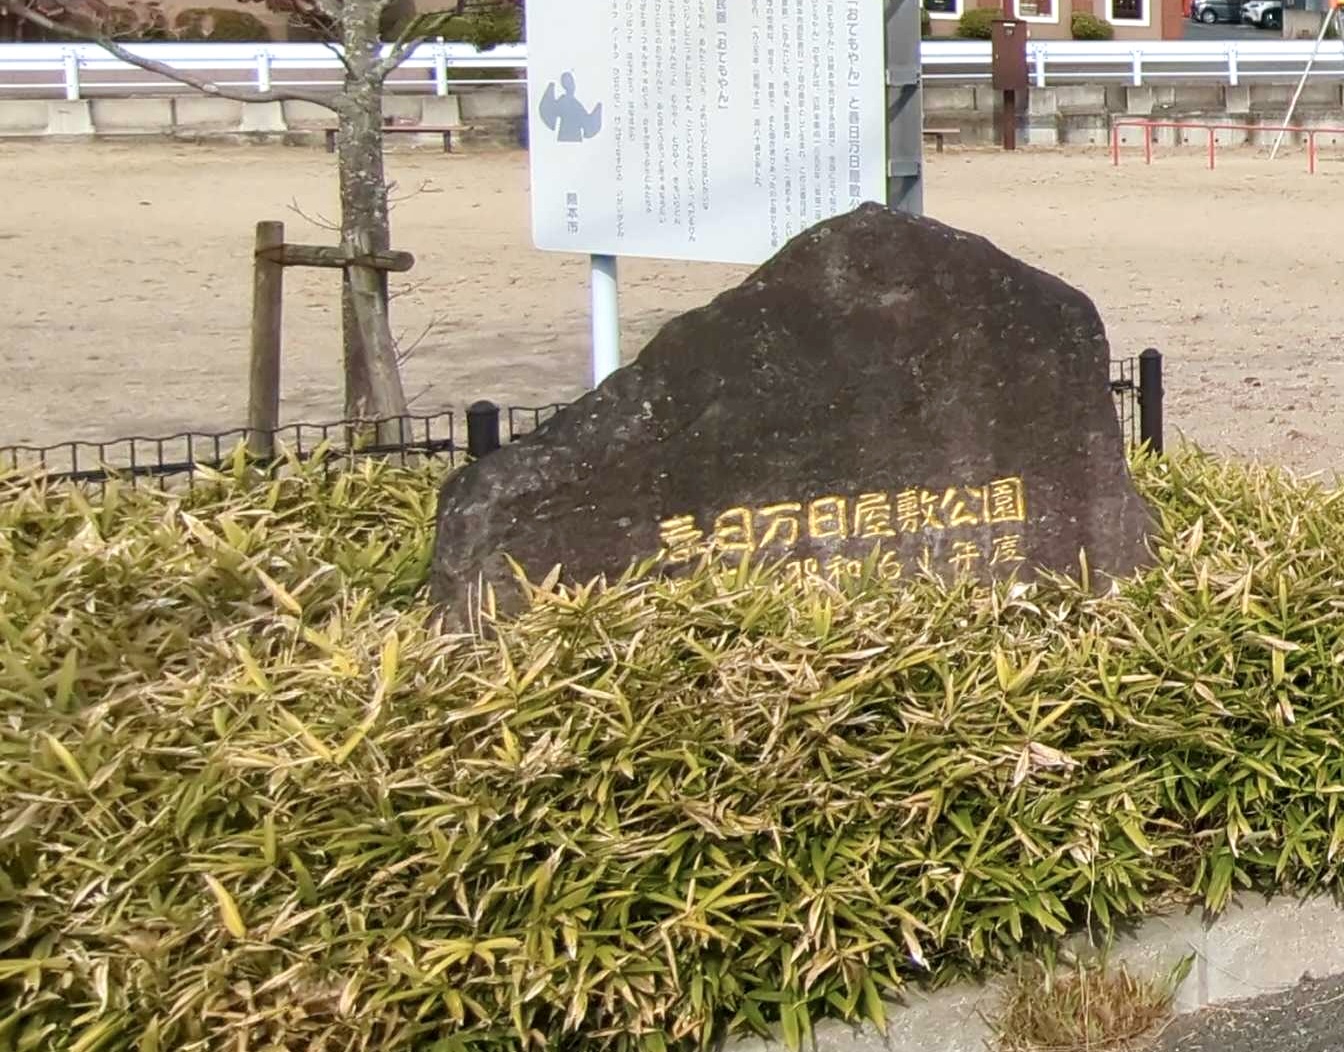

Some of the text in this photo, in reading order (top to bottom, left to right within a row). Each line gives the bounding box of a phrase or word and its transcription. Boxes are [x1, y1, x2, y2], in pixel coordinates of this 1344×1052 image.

[658, 476, 1026, 562] 春日万日屋敷公園
